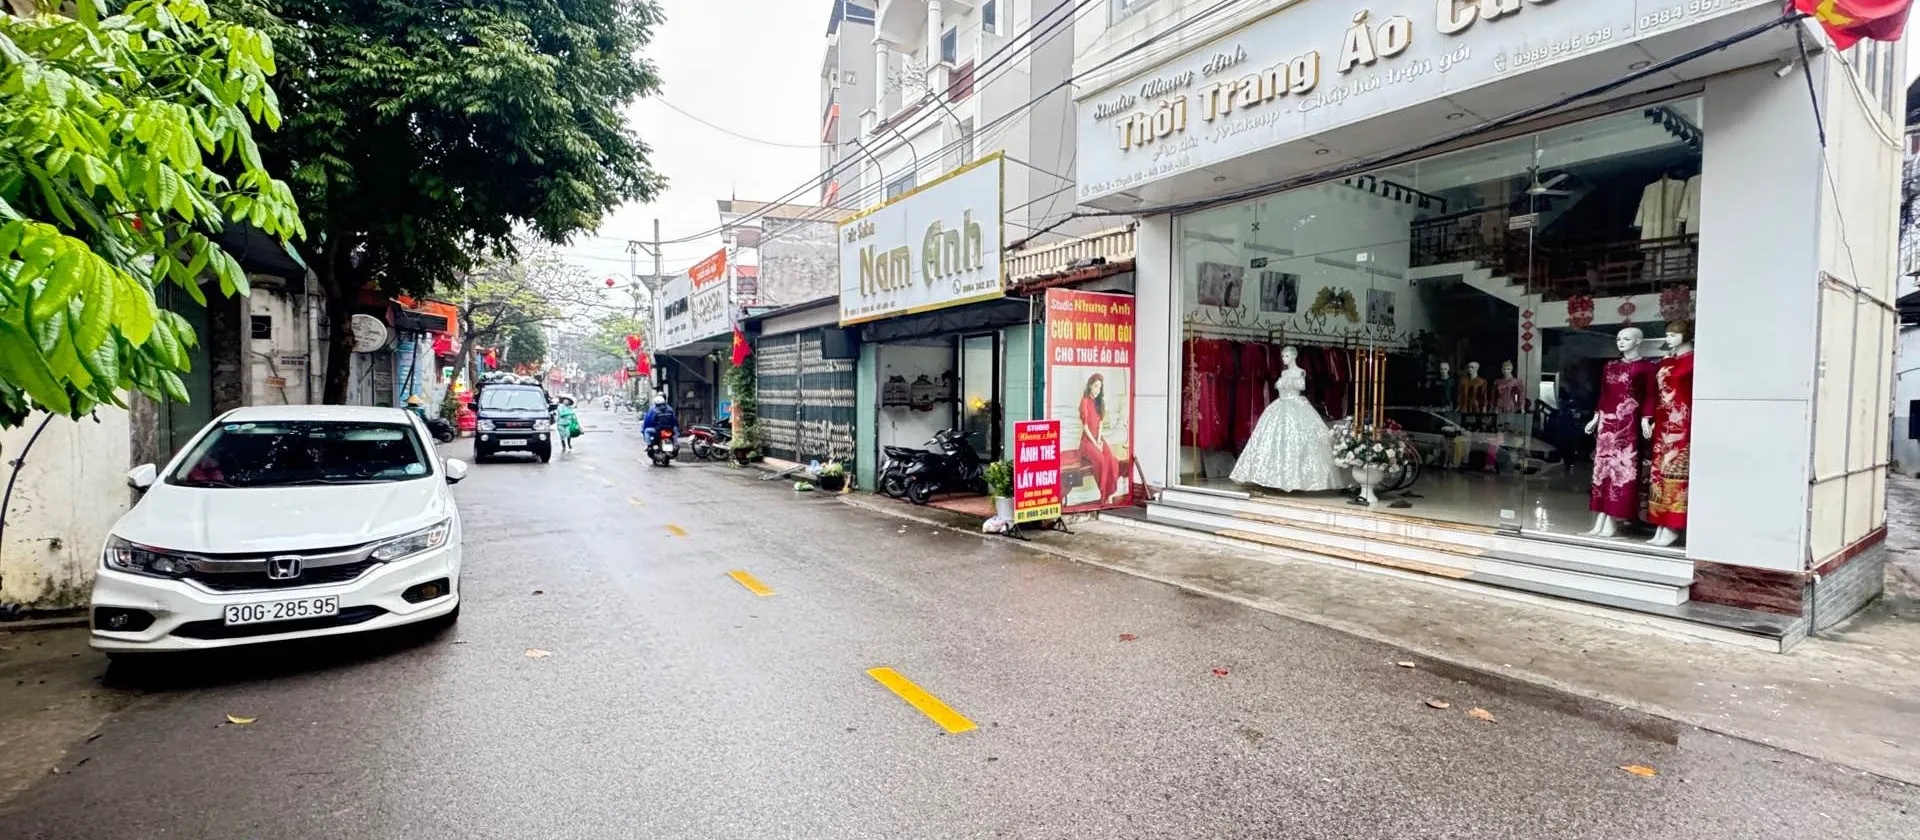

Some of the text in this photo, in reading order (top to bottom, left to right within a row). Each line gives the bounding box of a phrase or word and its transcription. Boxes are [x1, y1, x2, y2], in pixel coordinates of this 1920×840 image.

[1513, 47, 1548, 67] 0989
[1553, 38, 1581, 56] 346
[1585, 26, 1613, 47] 618
[1639, 6, 1683, 30] 0384
[1117, 95, 1187, 152] Thời
[1199, 51, 1320, 122] Trang
[1337, 9, 1413, 74] Áo
[859, 208, 985, 297] Nam Anh
[1050, 298, 1131, 317] Studio Nhung Anh
[1055, 345, 1129, 364] CHO THUÊ ÁO DÀI
[1017, 468, 1058, 489] LẤY NGAY
[229, 597, 336, 624] 30G-285.95
